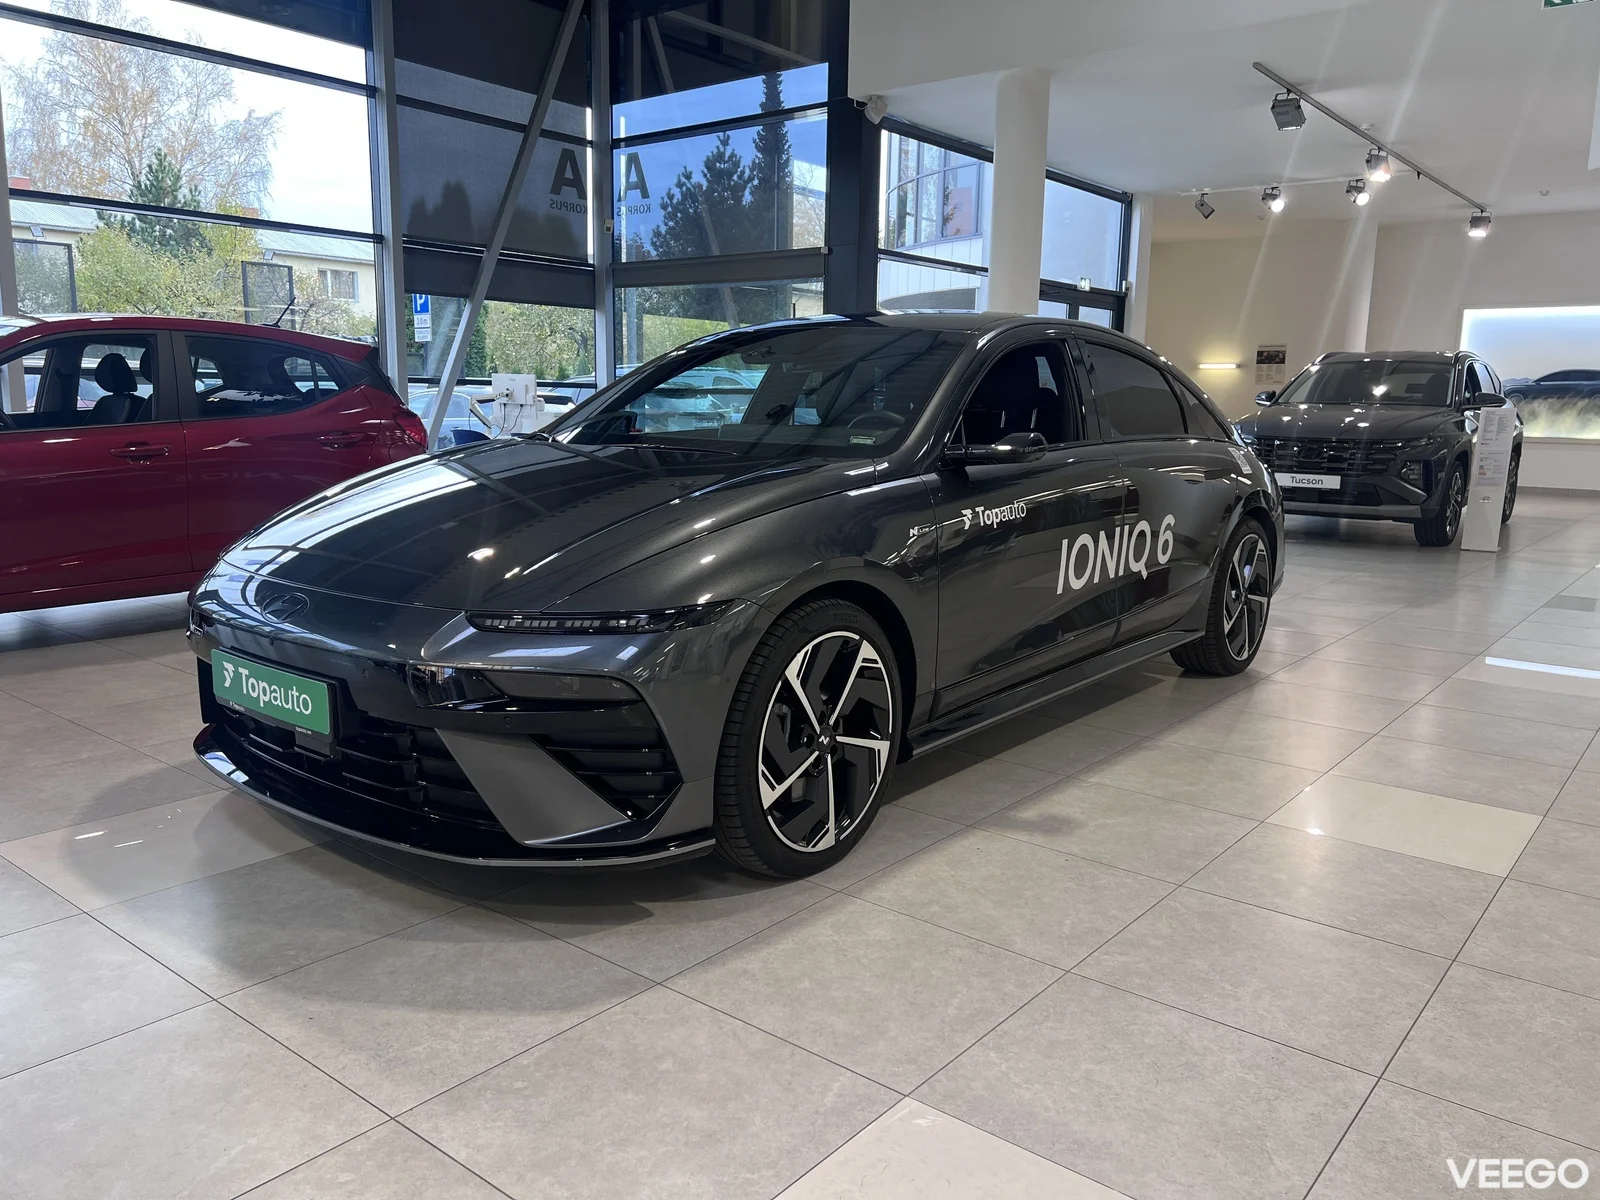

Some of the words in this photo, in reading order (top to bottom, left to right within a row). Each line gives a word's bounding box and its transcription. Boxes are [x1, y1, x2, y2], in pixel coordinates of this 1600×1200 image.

[416, 294, 425, 311] P
[1290, 476, 1324, 485] Tucson
[975, 502, 1027, 528] Topauto
[1057, 520, 1151, 594] IONIQ
[1157, 514, 1176, 565] 6
[238, 667, 312, 715] Topauto
